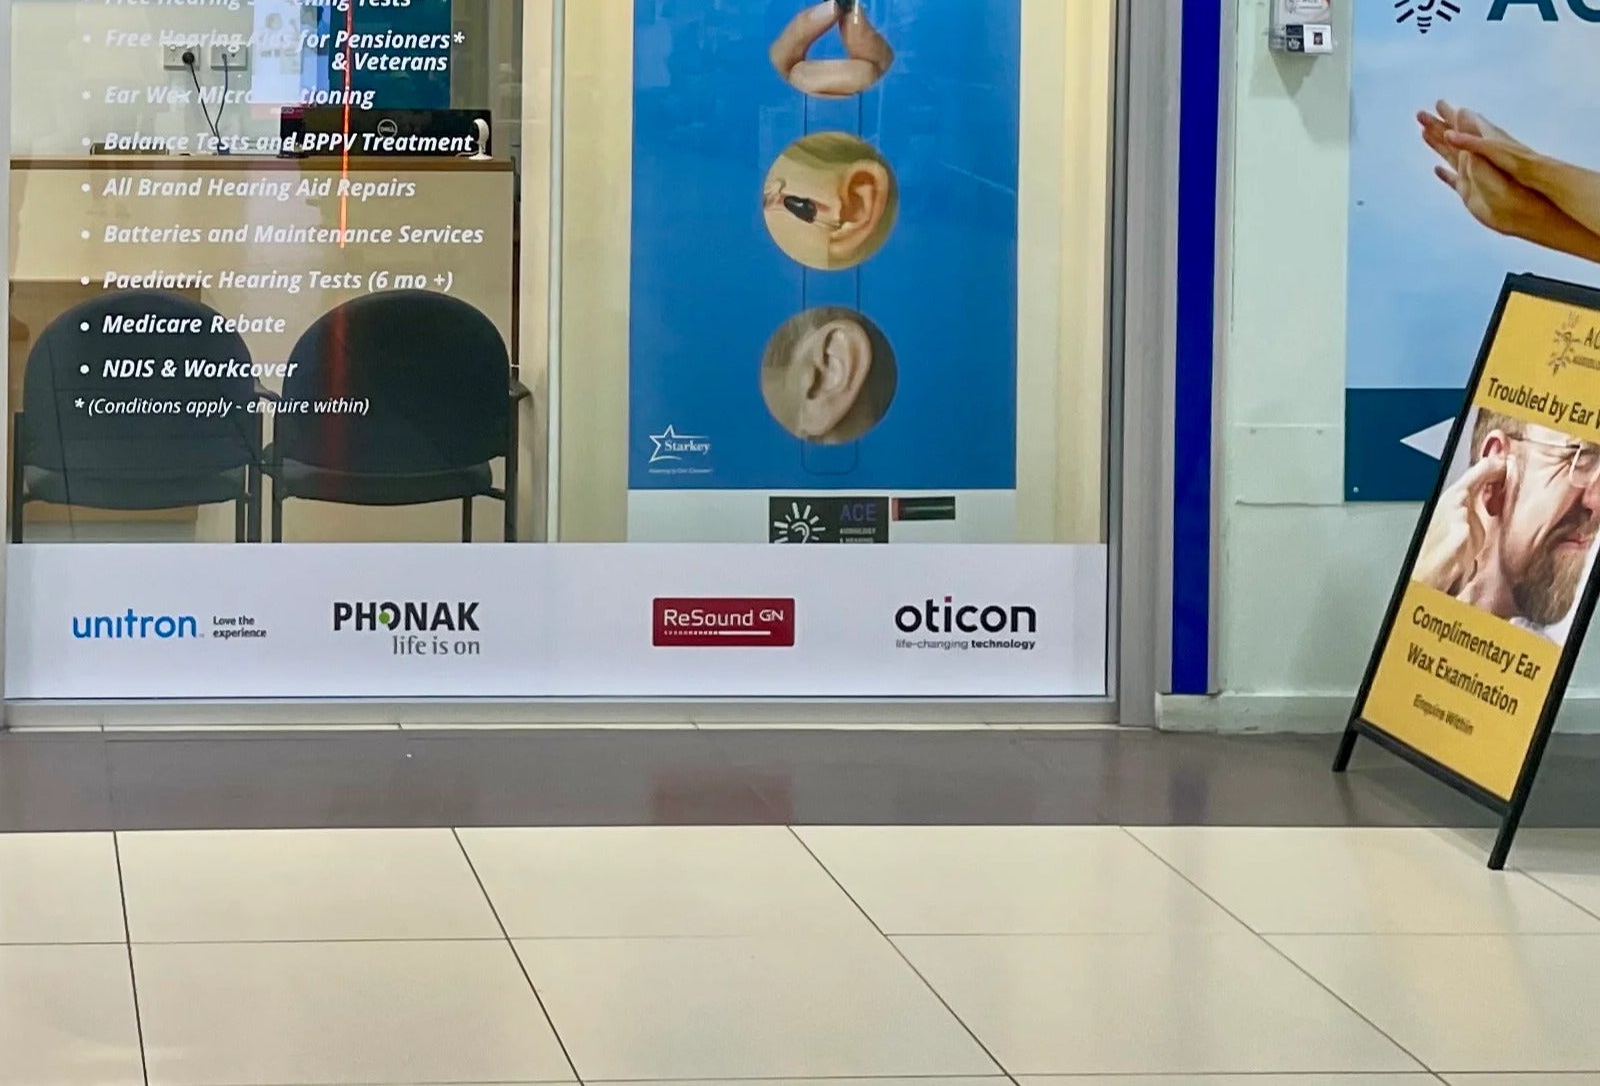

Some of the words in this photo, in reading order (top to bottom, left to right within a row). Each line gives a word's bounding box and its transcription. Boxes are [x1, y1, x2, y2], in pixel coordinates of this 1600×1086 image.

[105, 30, 151, 47] Free
[159, 30, 243, 52] Hearing
[297, 29, 330, 53] for
[332, 52, 348, 71] &
[354, 52, 447, 71] Veterans
[104, 87, 141, 103] Ear
[147, 87, 190, 104] Wax
[104, 132, 188, 151] Balance
[196, 133, 250, 152] Tests
[256, 132, 298, 152] and
[302, 133, 357, 152] BPPV
[361, 132, 474, 152] Treatment
[103, 178, 132, 196] All
[138, 178, 201, 196] Brand
[208, 178, 291, 200] Hearing
[297, 178, 330, 196] Aid
[337, 179, 415, 200] Repairs
[104, 225, 201, 243] Batteries
[207, 225, 247, 243] and
[254, 225, 392, 243] Maintenance
[398, 226, 483, 244] Services
[103, 270, 212, 289] Paediatric
[218, 271, 301, 294] Hearing
[308, 271, 361, 289] Tests
[368, 271, 387, 292] (6
[393, 276, 427, 289] mo
[433, 271, 453, 292] +)
[102, 315, 202, 333] Medicare
[210, 315, 286, 333] Rebate
[102, 360, 154, 378] NDIS
[160, 360, 178, 378] &
[184, 359, 298, 378] Workcover
[88, 397, 181, 416] (Conditions
[185, 398, 233, 417] apply
[247, 398, 309, 418] enquire
[313, 397, 370, 416] within)
[1487, 377, 1549, 413] Troubled
[1548, 395, 1569, 423] by
[1569, 402, 1594, 425] Ear
[665, 439, 710, 455] Starkey
[840, 503, 877, 521] ACE
[73, 609, 197, 639] unitron
[213, 616, 236, 626] Love
[238, 616, 255, 626] the
[333, 602, 480, 632] PHONAK
[664, 609, 753, 627] ReSound
[759, 609, 784, 622] GN
[895, 596, 1036, 633] oticon
[213, 628, 267, 639] experience
[1413, 605, 1515, 673] Complimentary
[1515, 653, 1541, 681] Ear
[392, 635, 427, 656] life
[432, 635, 448, 655] is
[453, 641, 480, 656] on
[895, 638, 968, 651] life-changing
[971, 639, 1035, 651] technology
[1407, 642, 1435, 674] Wax
[1435, 657, 1518, 715] Examination
